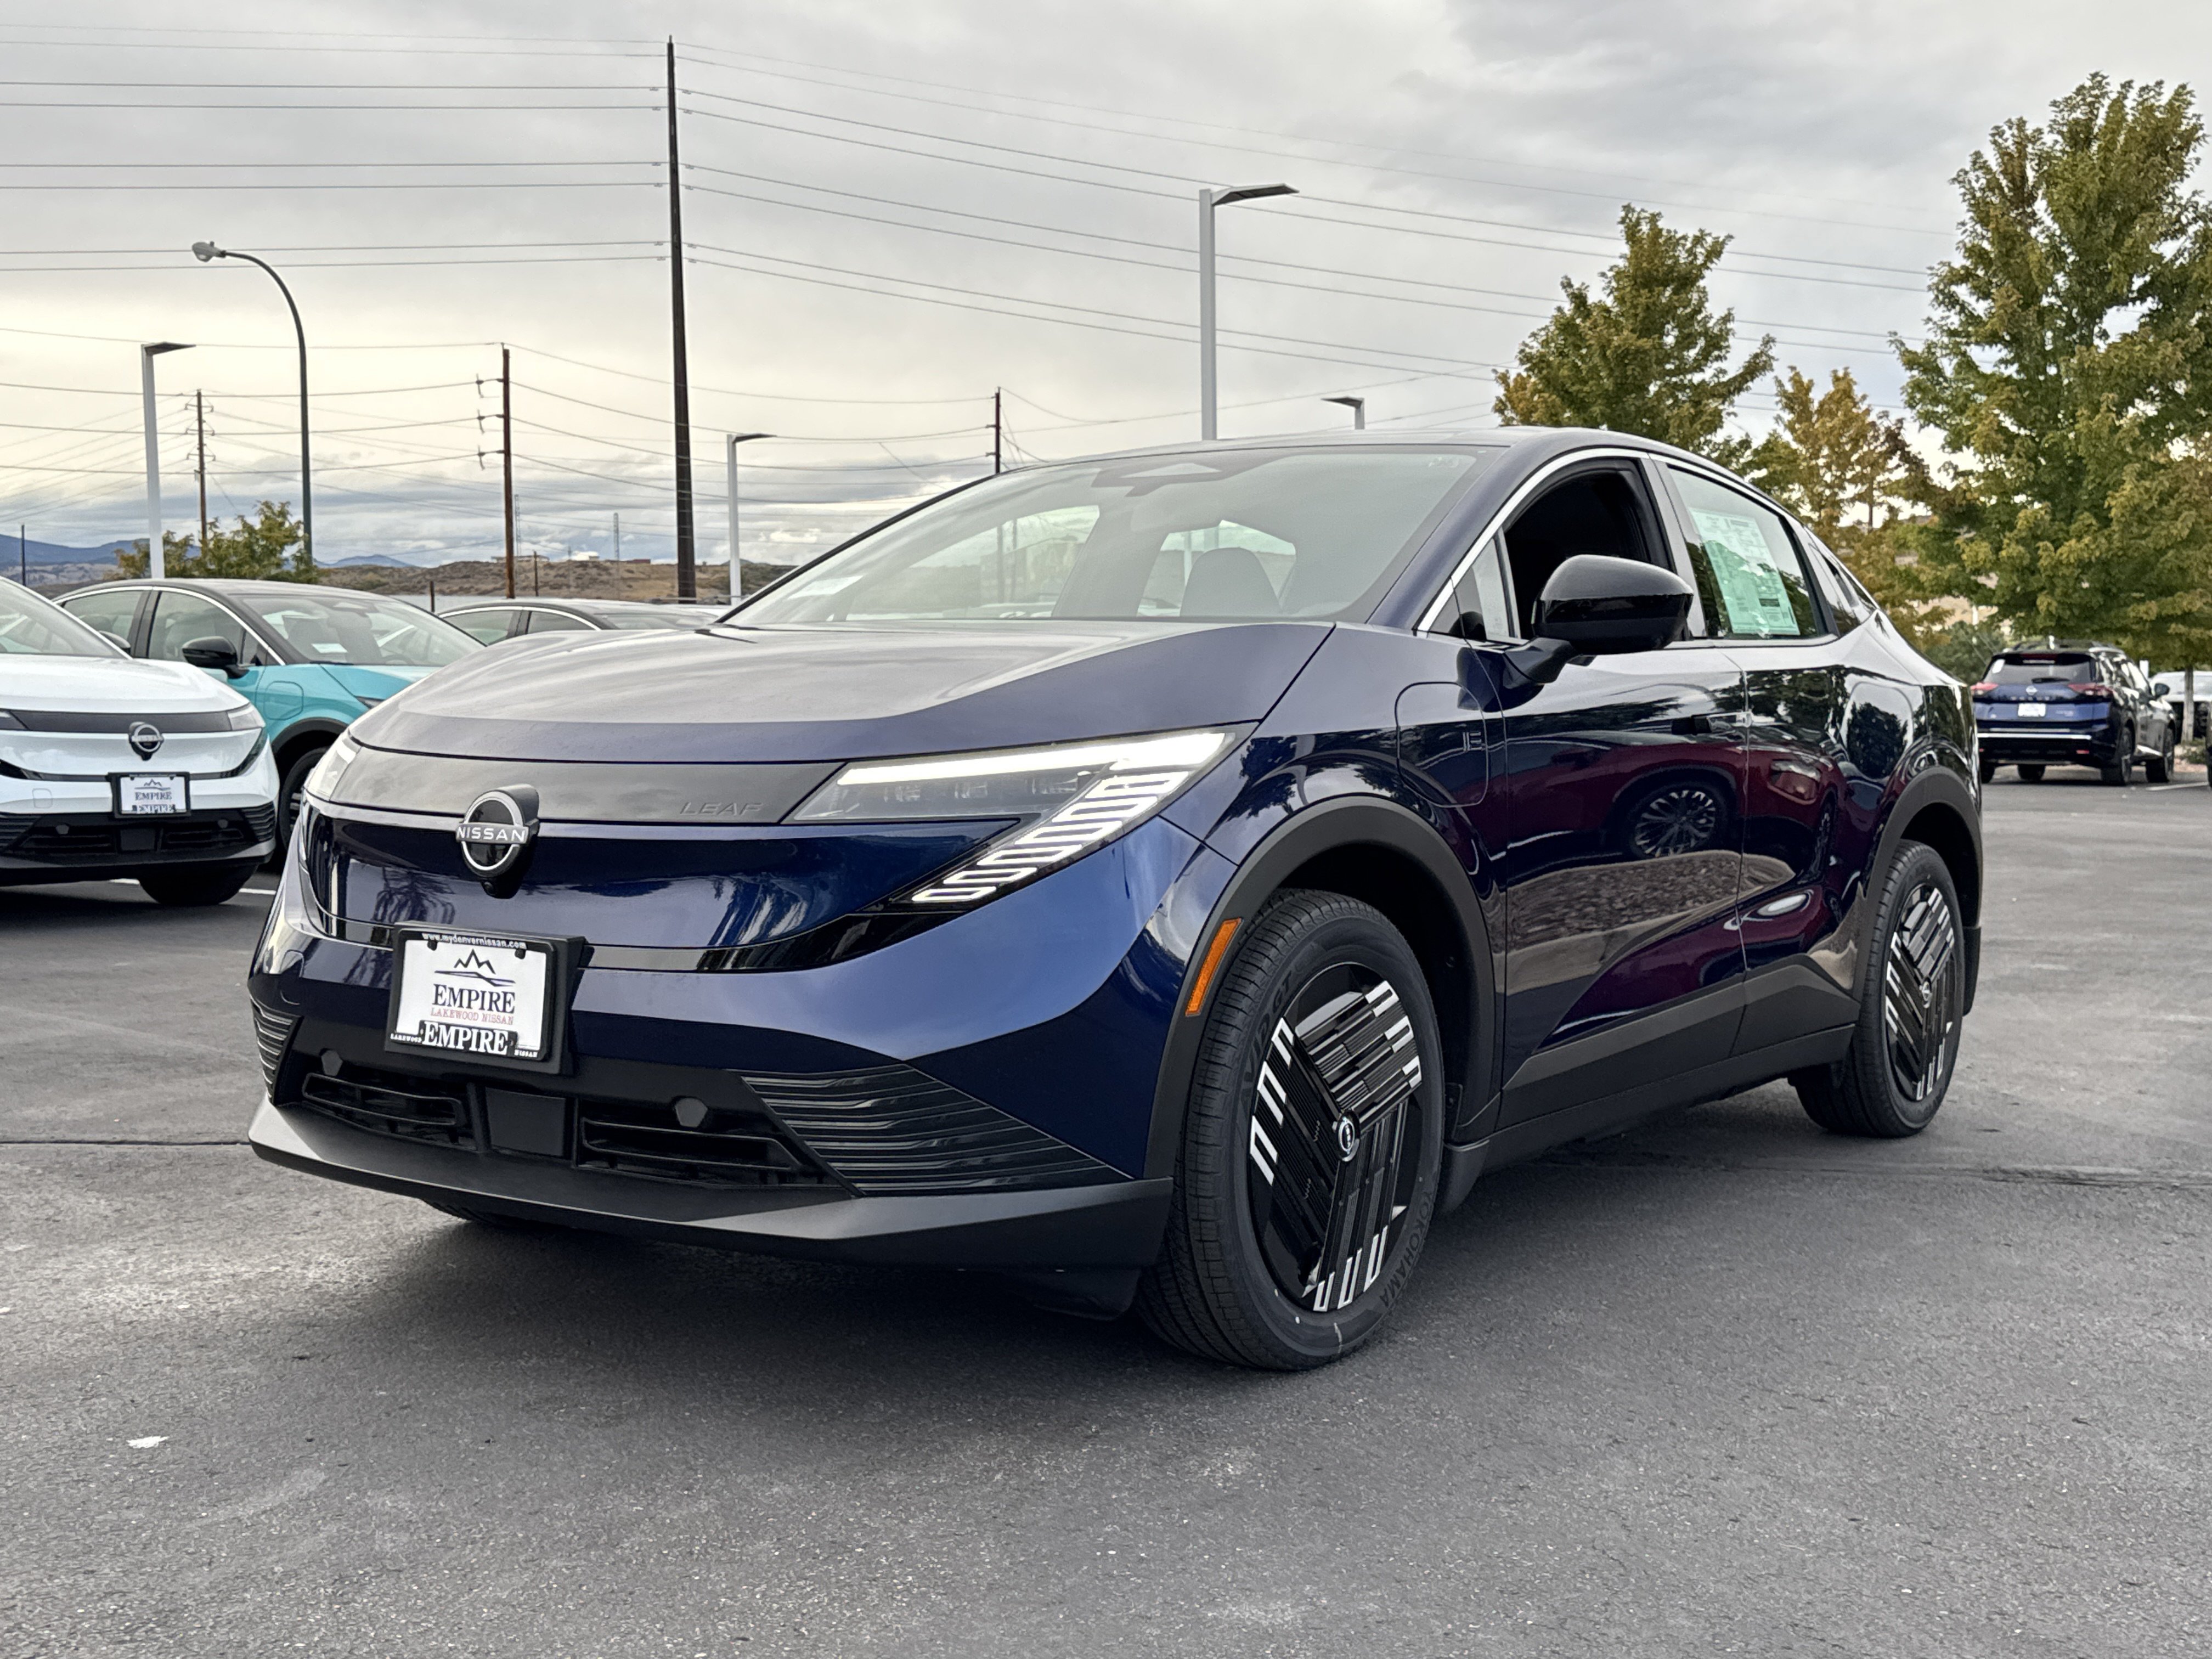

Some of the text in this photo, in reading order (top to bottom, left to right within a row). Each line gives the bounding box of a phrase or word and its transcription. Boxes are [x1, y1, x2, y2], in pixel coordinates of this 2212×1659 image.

[136, 792, 172, 800] EMPIRE
[680, 802, 763, 816] LEAF
[456, 826, 526, 842] NISSAN
[432, 984, 515, 1013] EMPIRE
[431, 1007, 515, 1025] LAKEWOOD NISSAN
[422, 1022, 508, 1055] EMPIRE
[1379, 1192, 1434, 1308] YOKOHAMA
